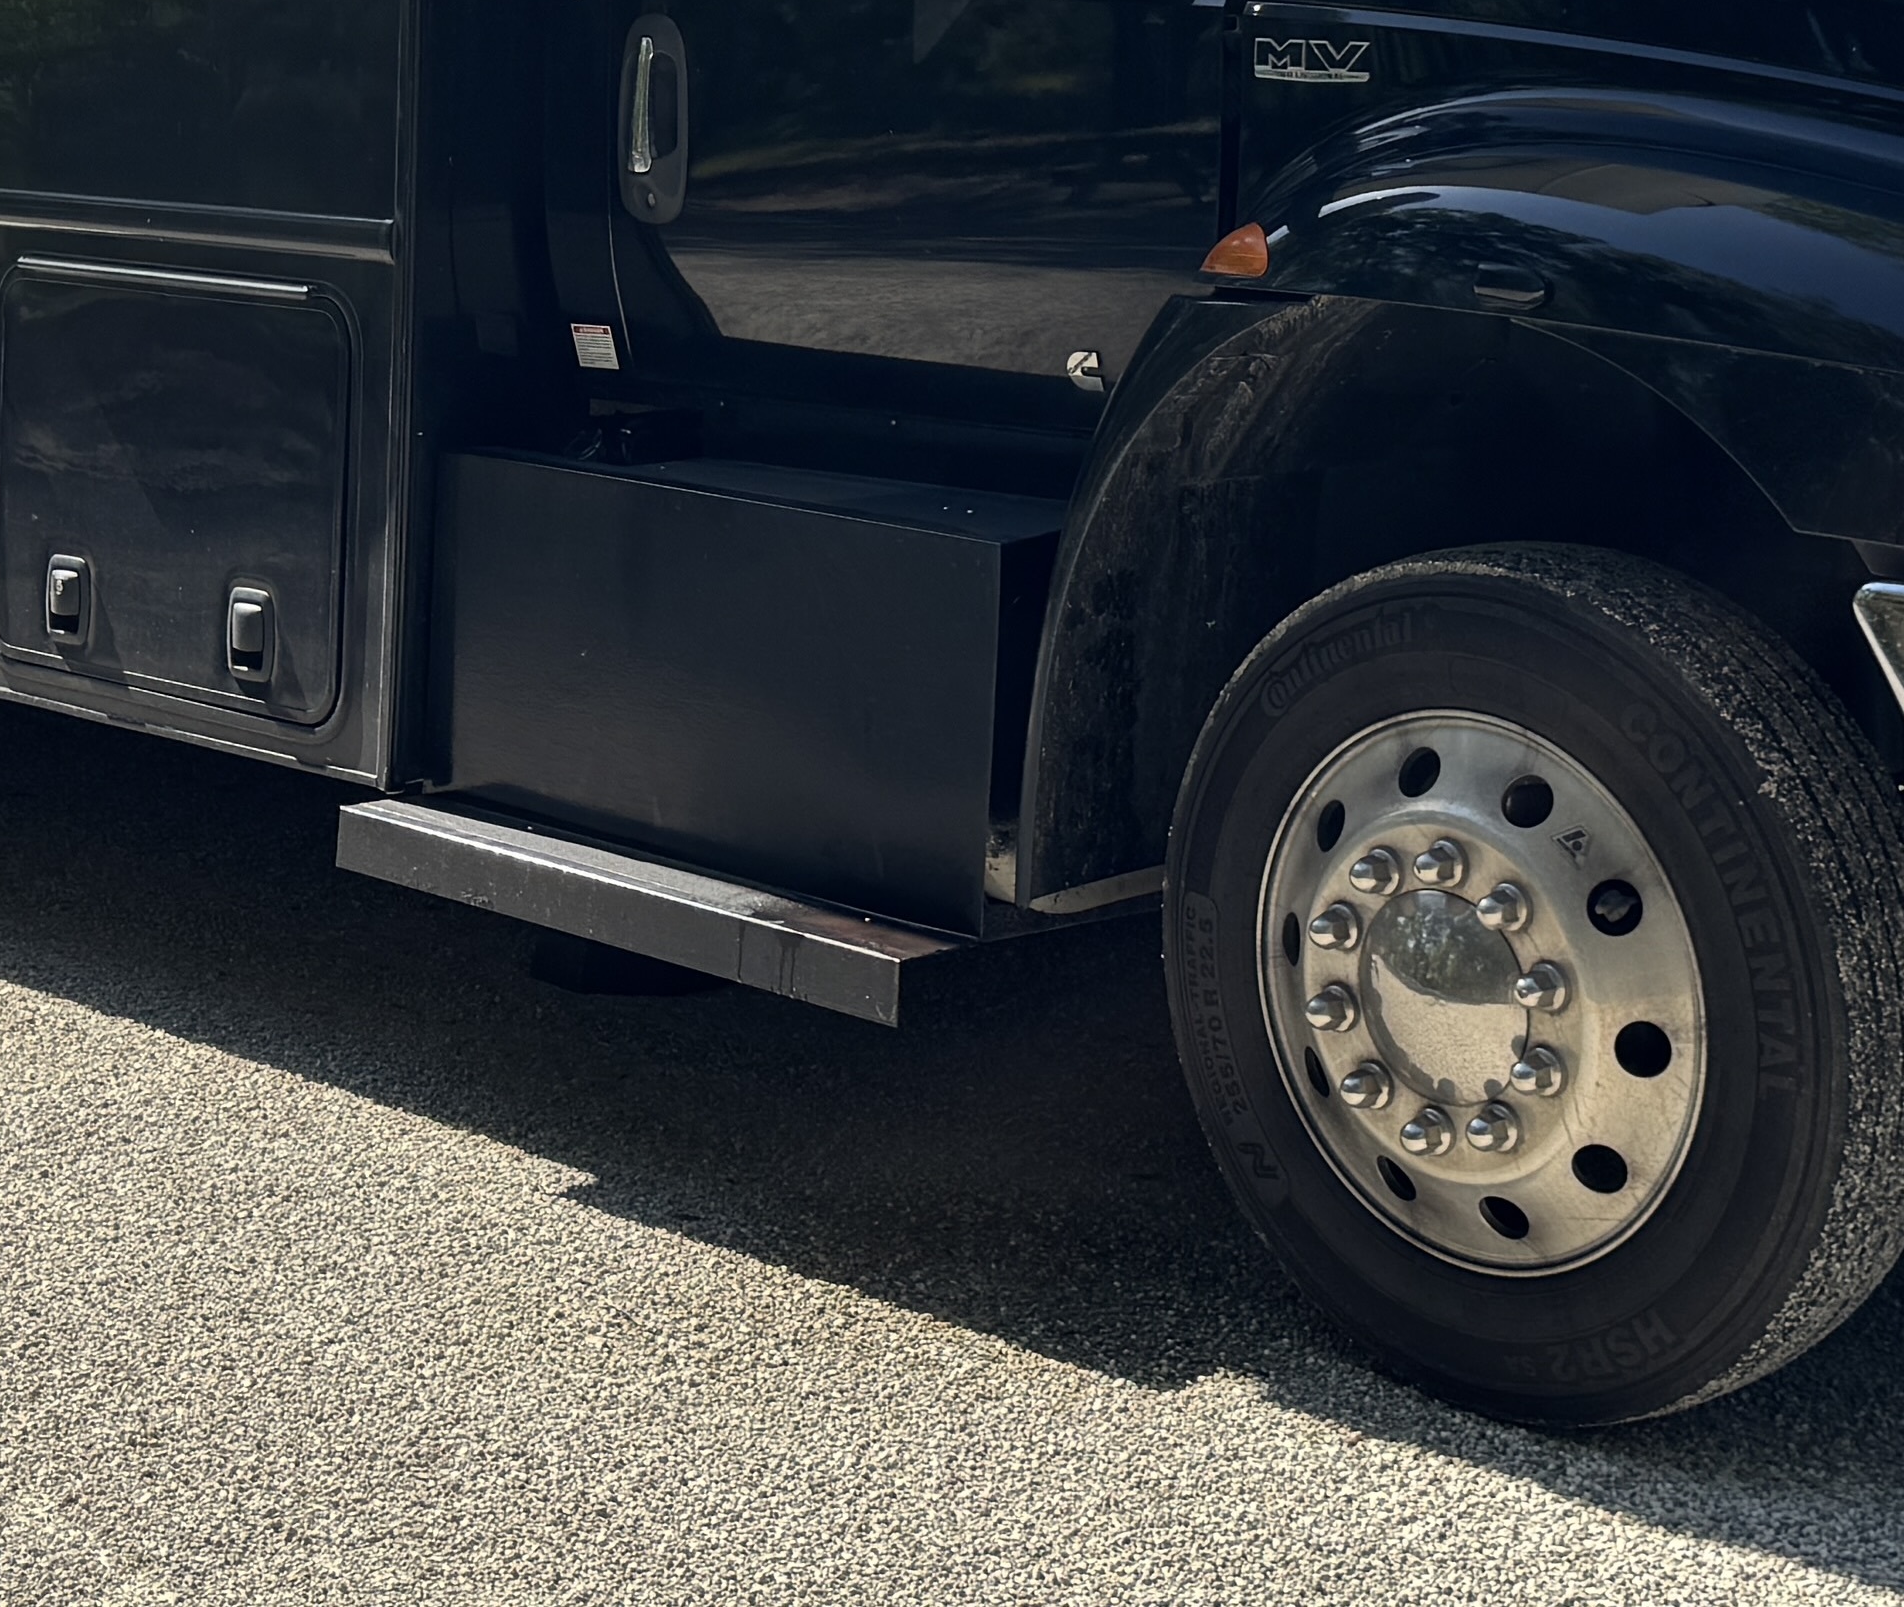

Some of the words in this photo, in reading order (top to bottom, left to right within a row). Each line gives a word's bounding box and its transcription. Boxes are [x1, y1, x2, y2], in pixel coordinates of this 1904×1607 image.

[1254, 37, 1371, 73] MV
[1260, 607, 1413, 717] Continental
[1621, 703, 1799, 1102] CONTINENTAL
